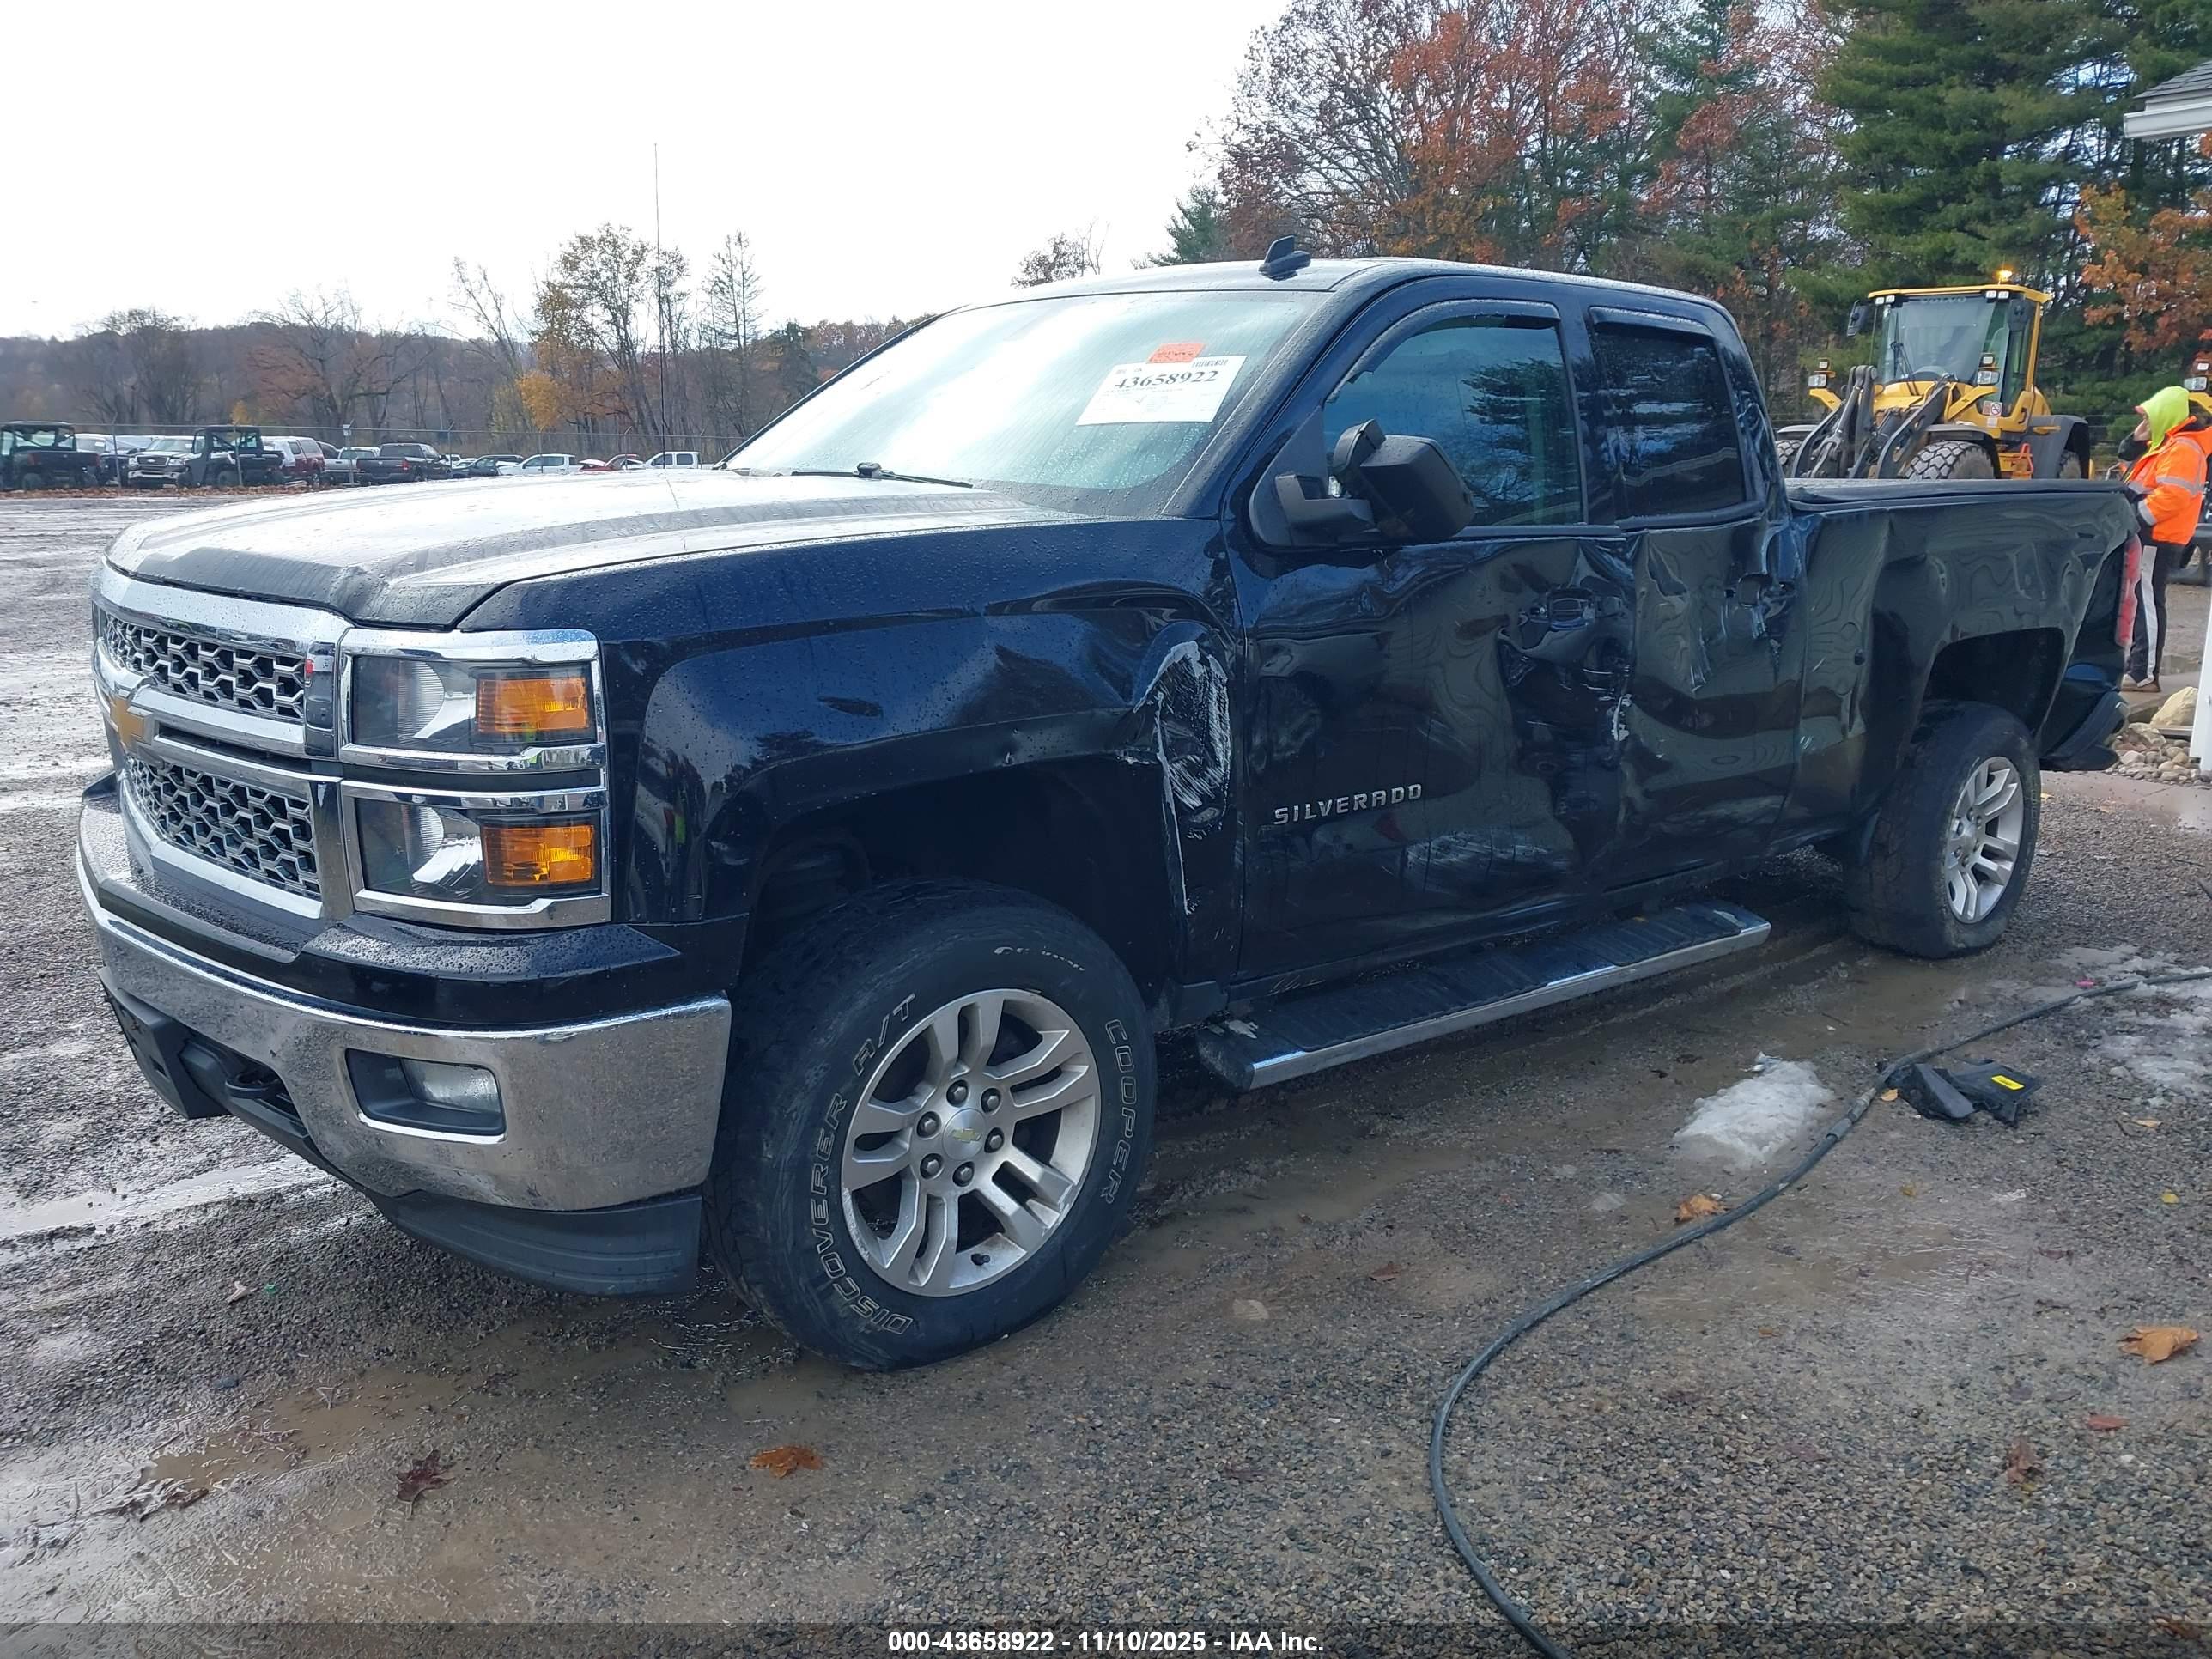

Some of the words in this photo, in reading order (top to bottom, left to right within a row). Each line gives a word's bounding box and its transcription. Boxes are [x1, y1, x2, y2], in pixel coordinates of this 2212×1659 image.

[1115, 370, 1219, 388] 43658922
[1273, 783, 1423, 825] SILVERADO
[853, 993, 916, 1077] A/T
[1104, 1018, 1138, 1204] COOPER
[810, 1092, 914, 1335] DISCOVERER
